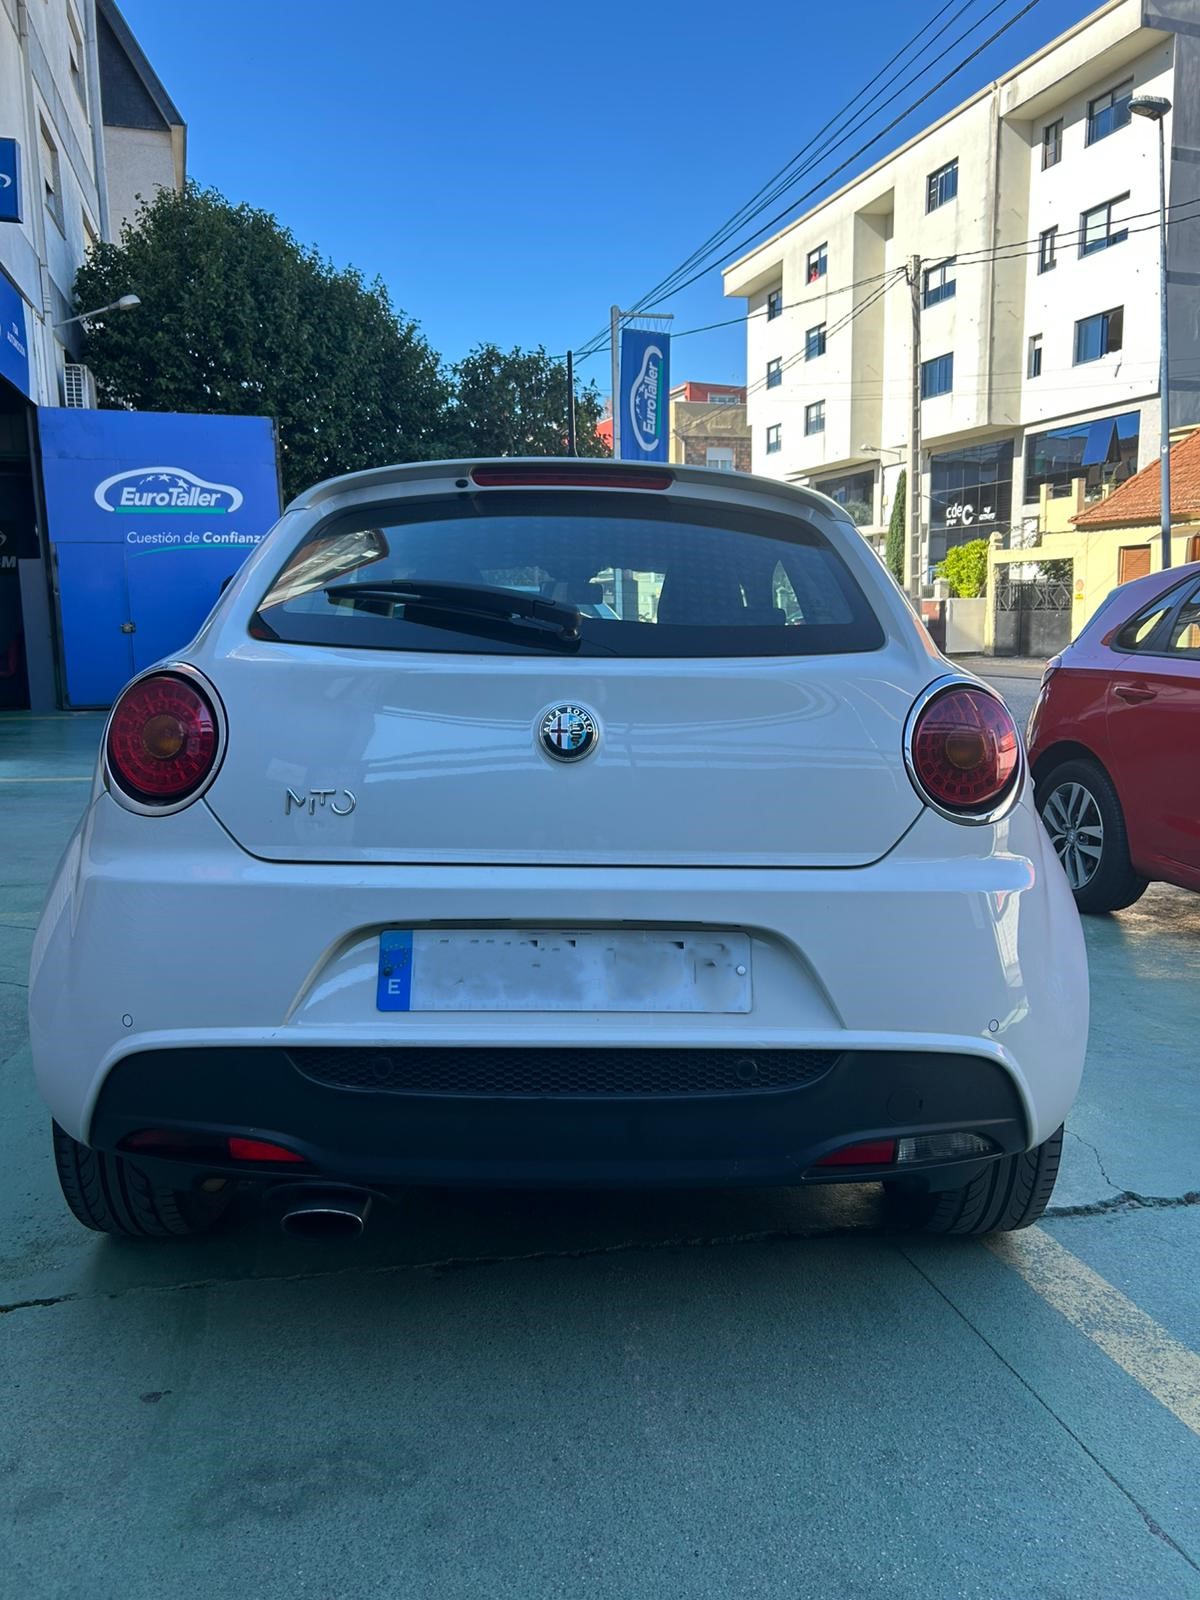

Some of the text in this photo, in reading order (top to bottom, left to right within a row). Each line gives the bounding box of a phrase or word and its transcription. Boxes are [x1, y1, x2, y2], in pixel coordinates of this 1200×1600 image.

[643, 361, 658, 435] EuroTaller
[120, 487, 220, 507] EuroTaller
[127, 531, 181, 544] Cuestión
[184, 532, 200, 544] de
[544, 707, 593, 733] ALFA ROMEO
[387, 978, 401, 995] E
